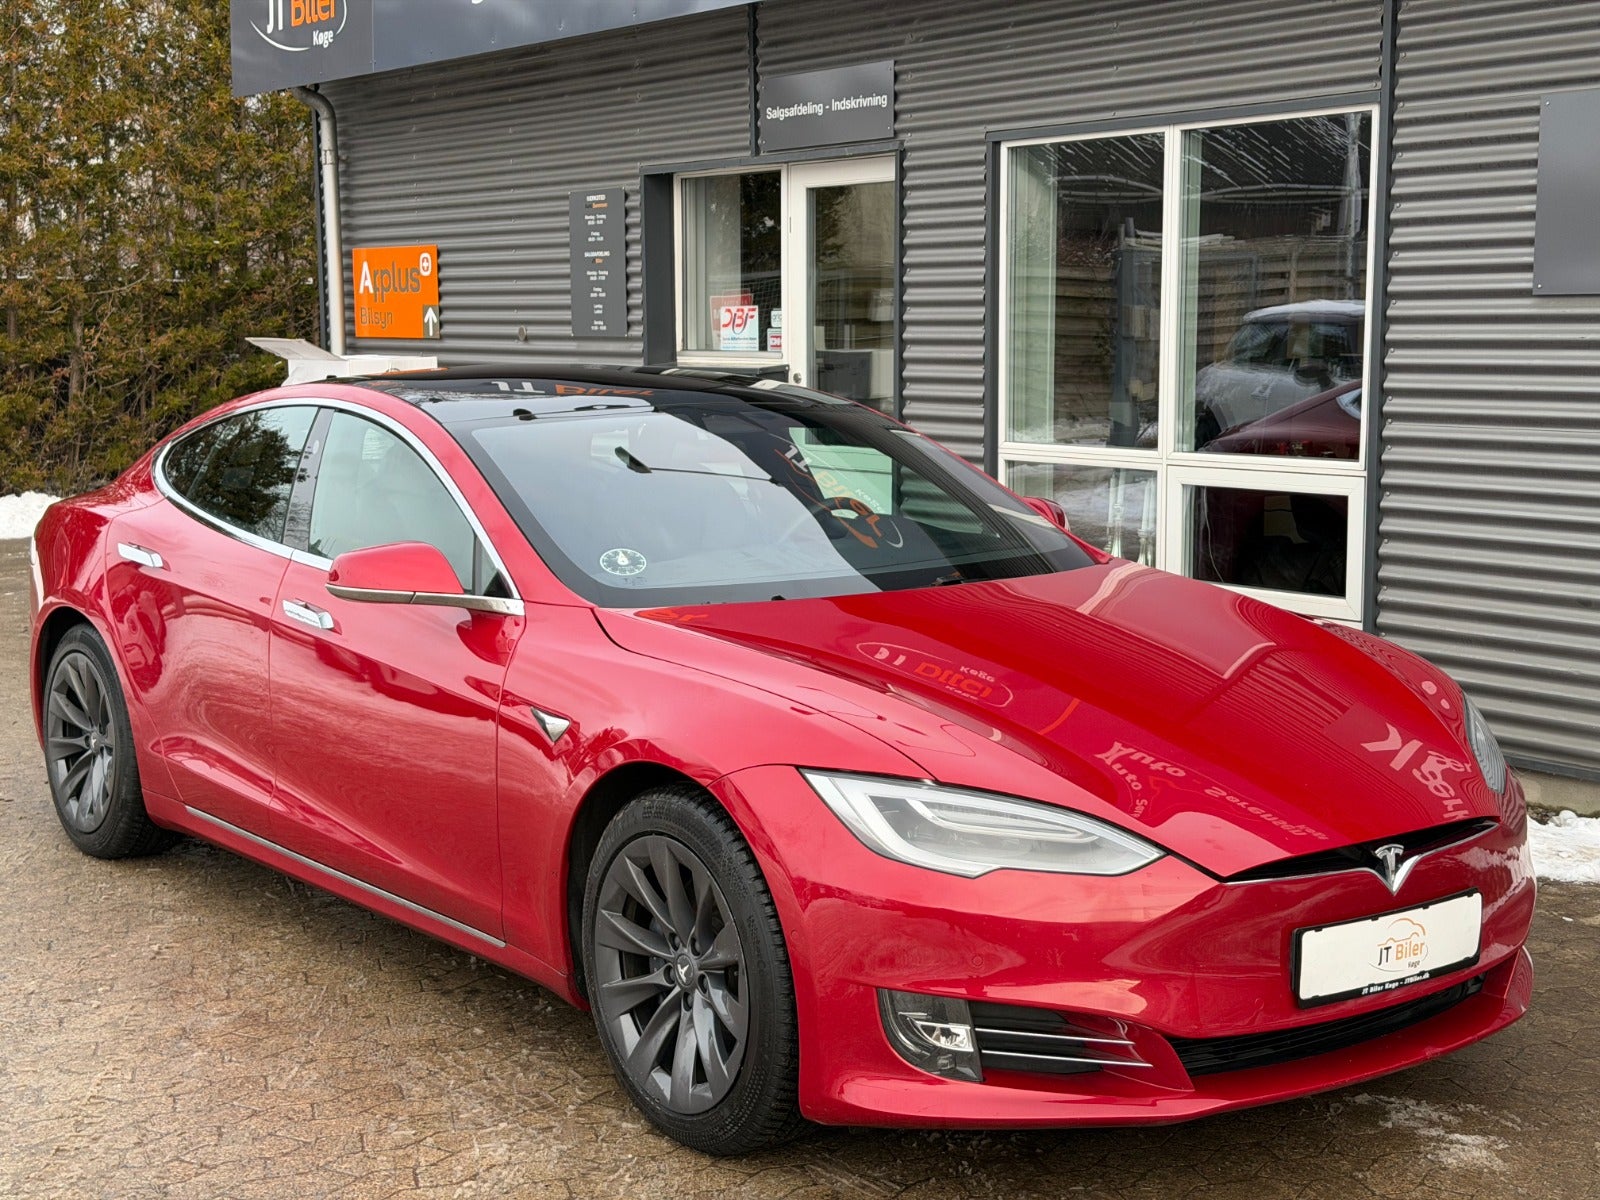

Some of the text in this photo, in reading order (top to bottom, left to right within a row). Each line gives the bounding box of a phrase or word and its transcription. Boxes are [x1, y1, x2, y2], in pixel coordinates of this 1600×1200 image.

[312, 30, 334, 48] Køge
[766, 102, 823, 121] Salgsafdeling
[831, 93, 888, 112] Indskrivning
[360, 306, 393, 329] Bilsyn
[1378, 941, 1425, 966] JT Biler
